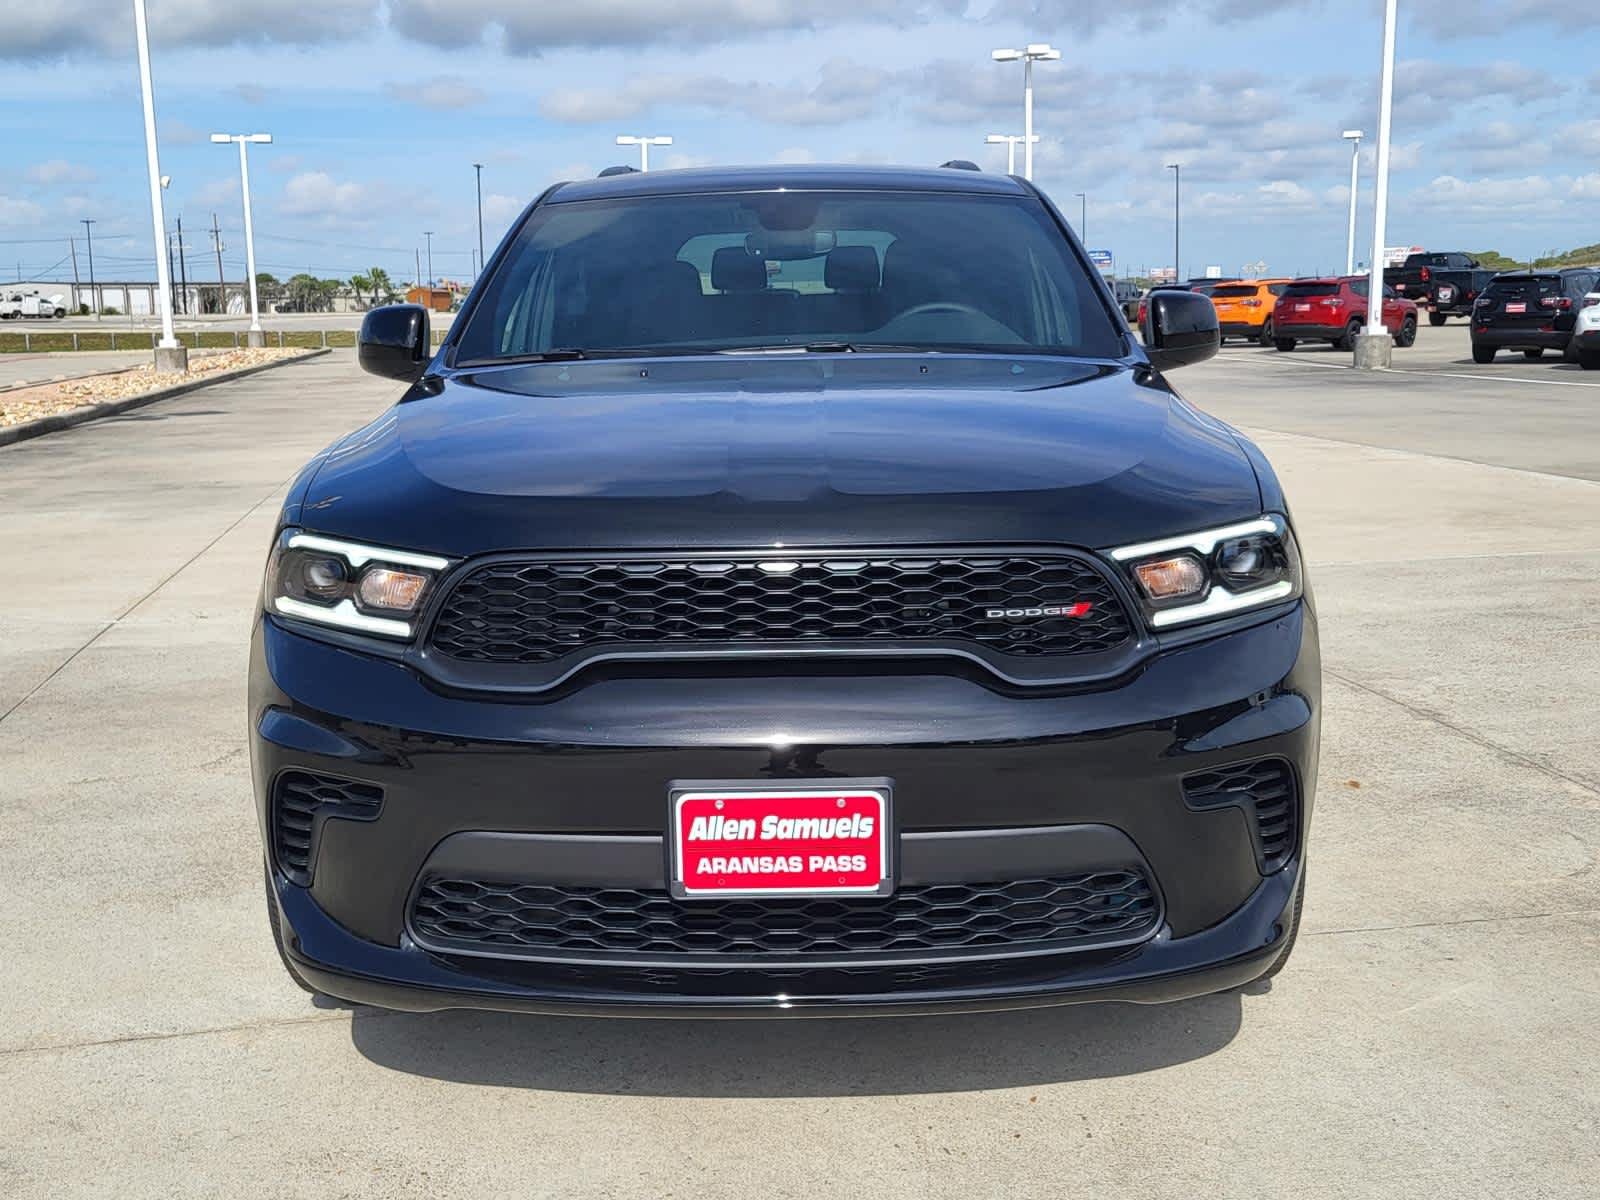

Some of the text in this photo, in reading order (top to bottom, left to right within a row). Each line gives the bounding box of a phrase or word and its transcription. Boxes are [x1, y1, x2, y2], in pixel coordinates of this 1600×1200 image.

[987, 606, 1077, 618] DODGE
[688, 813, 874, 841] Allen Samuels
[697, 854, 867, 874] ARANSAS PASS
